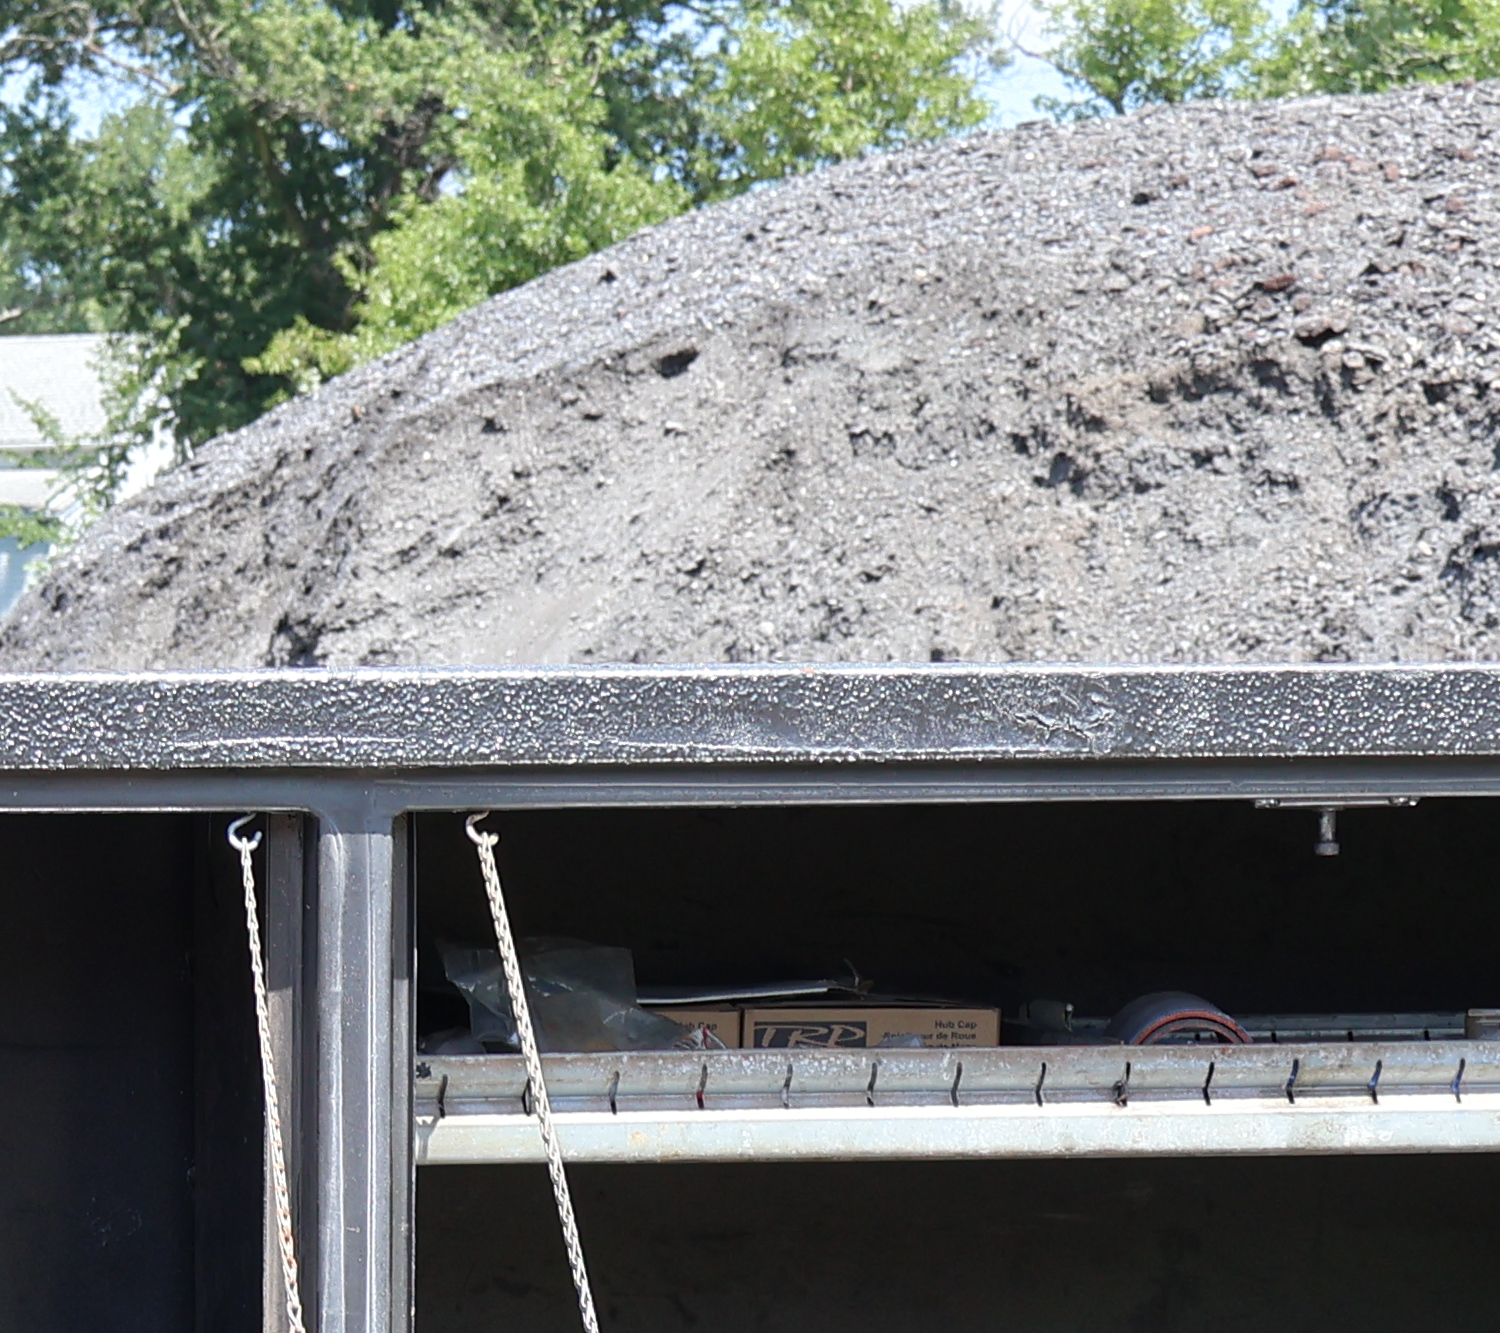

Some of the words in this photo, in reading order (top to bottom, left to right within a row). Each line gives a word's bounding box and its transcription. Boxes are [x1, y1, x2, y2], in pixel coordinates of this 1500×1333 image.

[934, 1020, 955, 1029] Hub
[957, 1020, 978, 1030] Cap
[754, 1022, 866, 1048] TRP
